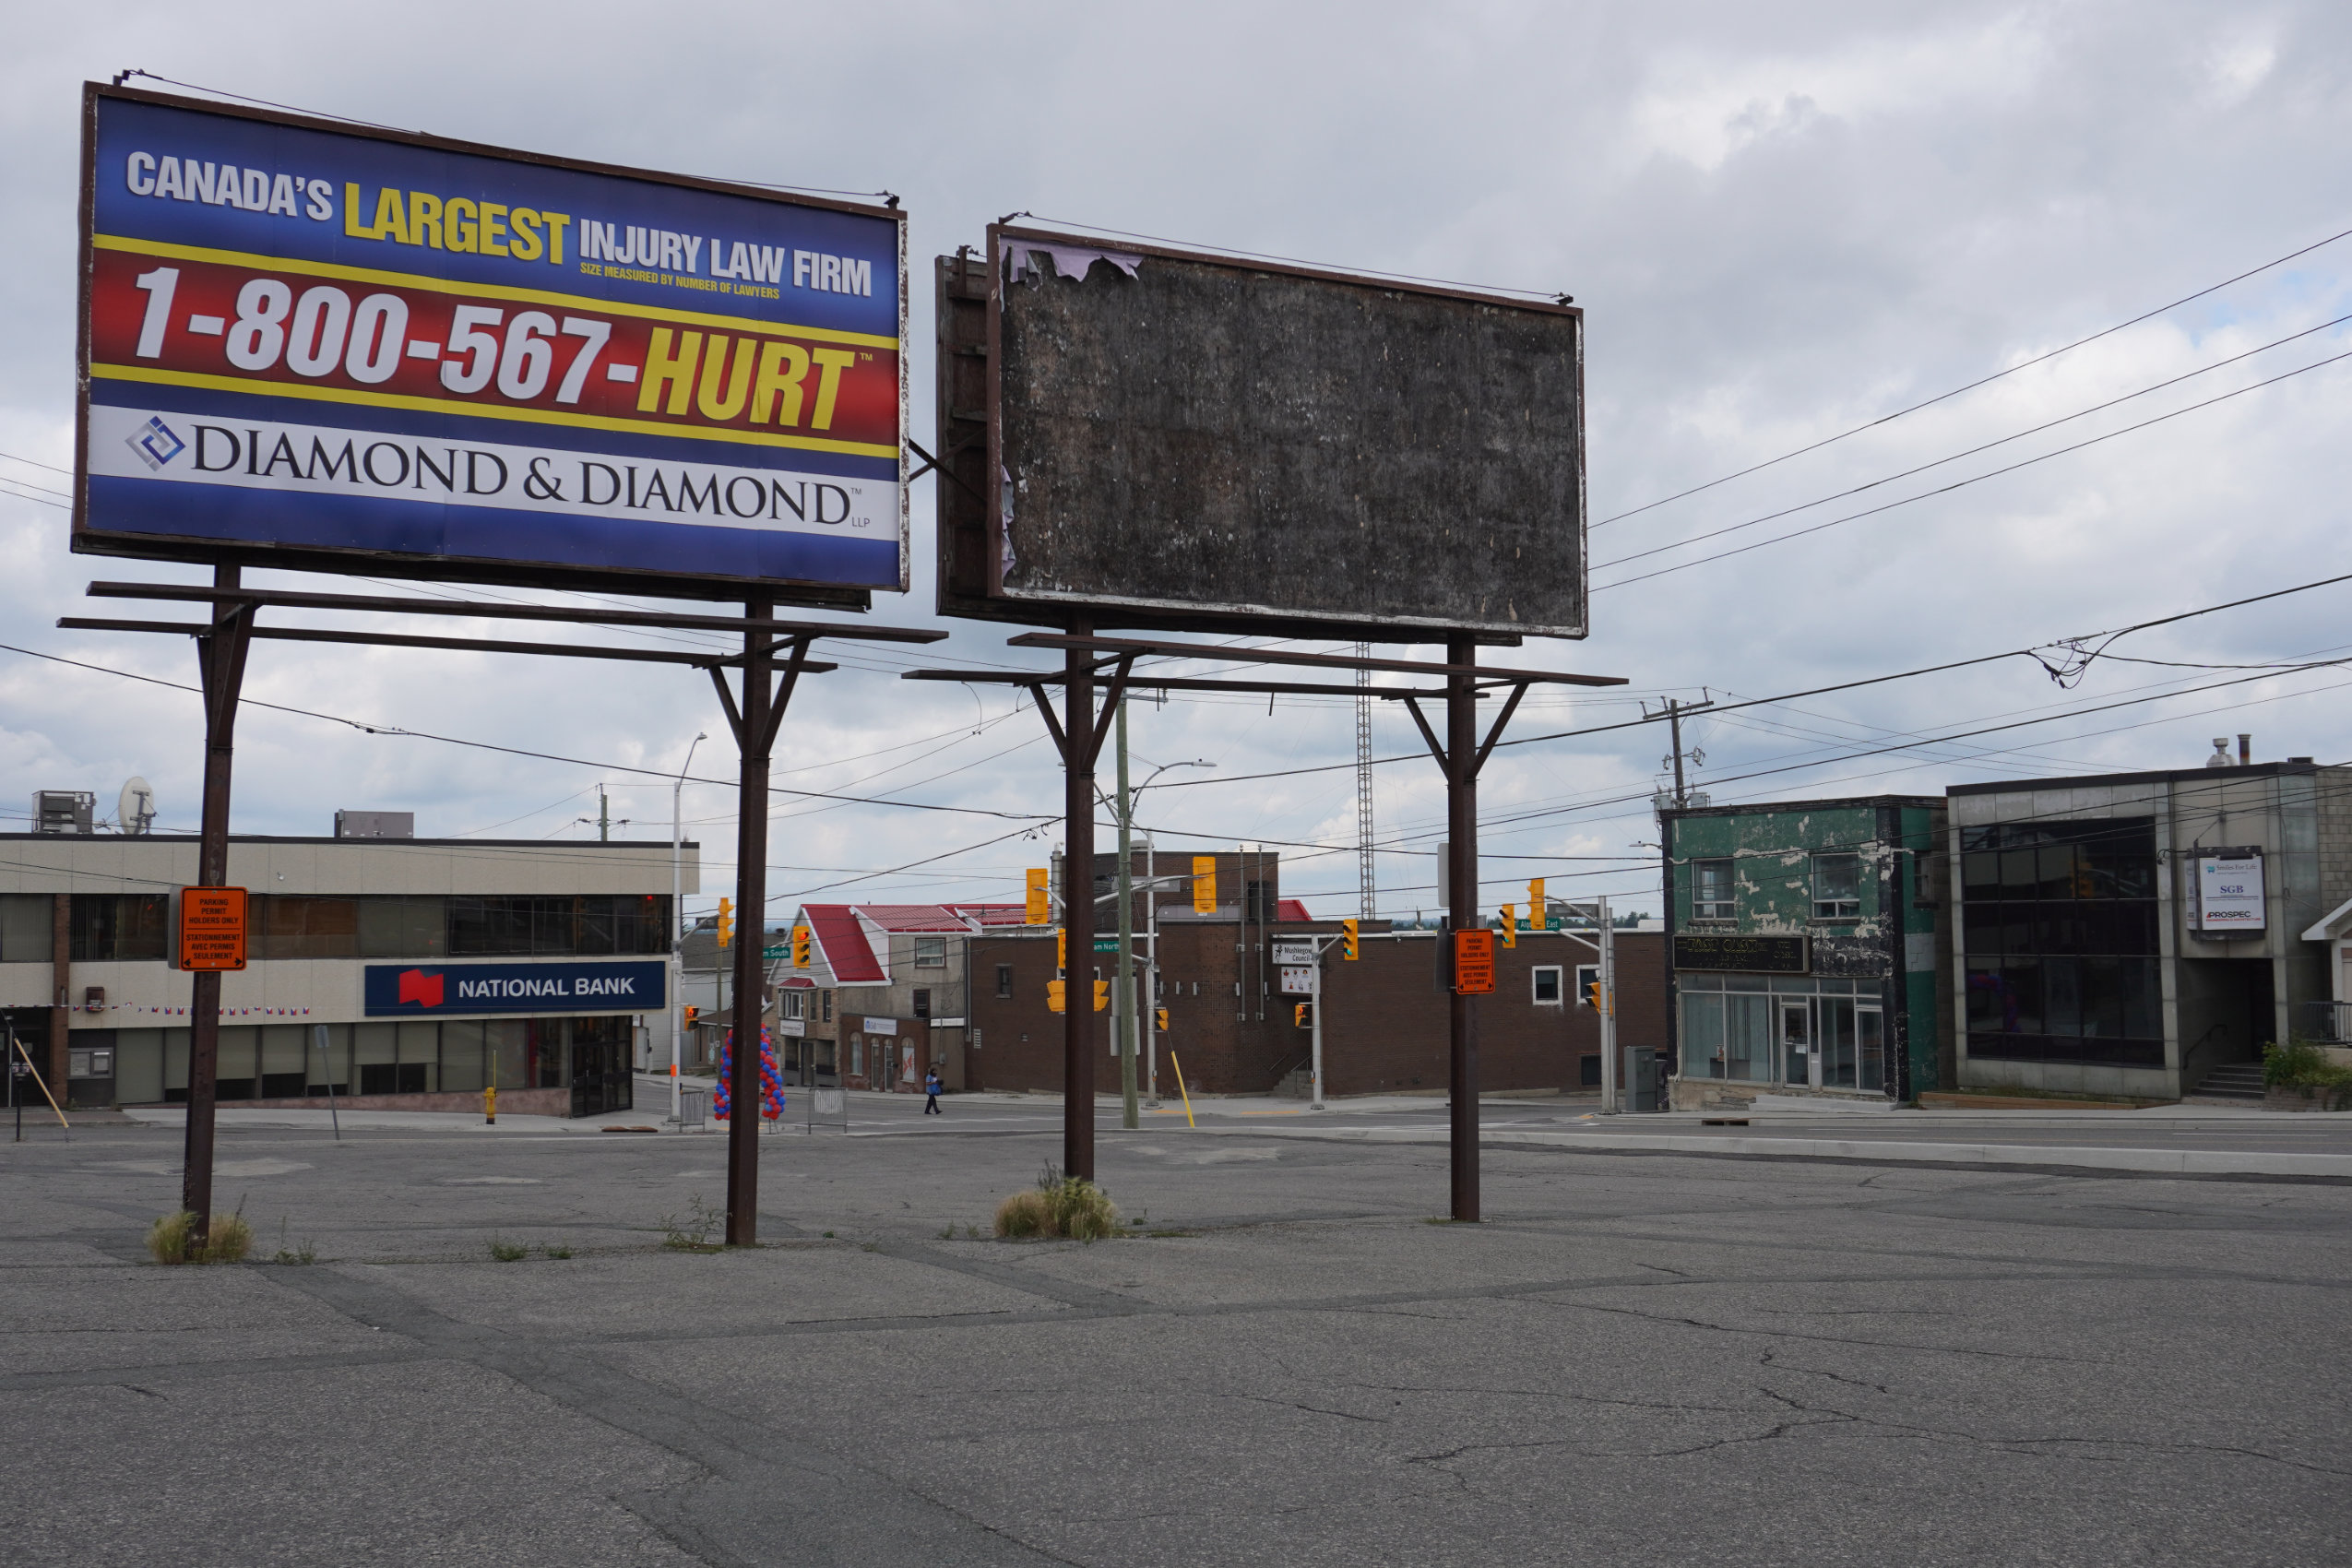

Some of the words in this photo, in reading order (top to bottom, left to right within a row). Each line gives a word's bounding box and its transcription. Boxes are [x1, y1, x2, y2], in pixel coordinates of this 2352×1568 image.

[127, 151, 333, 221] CANADA'S
[345, 182, 571, 265] LARGEST
[579, 219, 703, 273] INJURY
[710, 238, 785, 284] LAW
[793, 249, 872, 297] FIRM
[580, 262, 602, 276] SIZE
[604, 267, 659, 283] MEASURED
[660, 276, 673, 287] BY
[675, 278, 718, 291] NUMBER
[719, 281, 732, 293] OF
[733, 284, 780, 300] LAWYERS
[190, 424, 508, 495] DIAMOND
[523, 457, 570, 503] &
[577, 461, 851, 525] DIAMOND
[851, 517, 871, 529] LLP
[2220, 885, 2244, 894] SGB
[1546, 920, 1559, 928] East
[769, 949, 790, 957] South
[458, 979, 570, 998] NATIONAL
[575, 977, 636, 996] BANK
